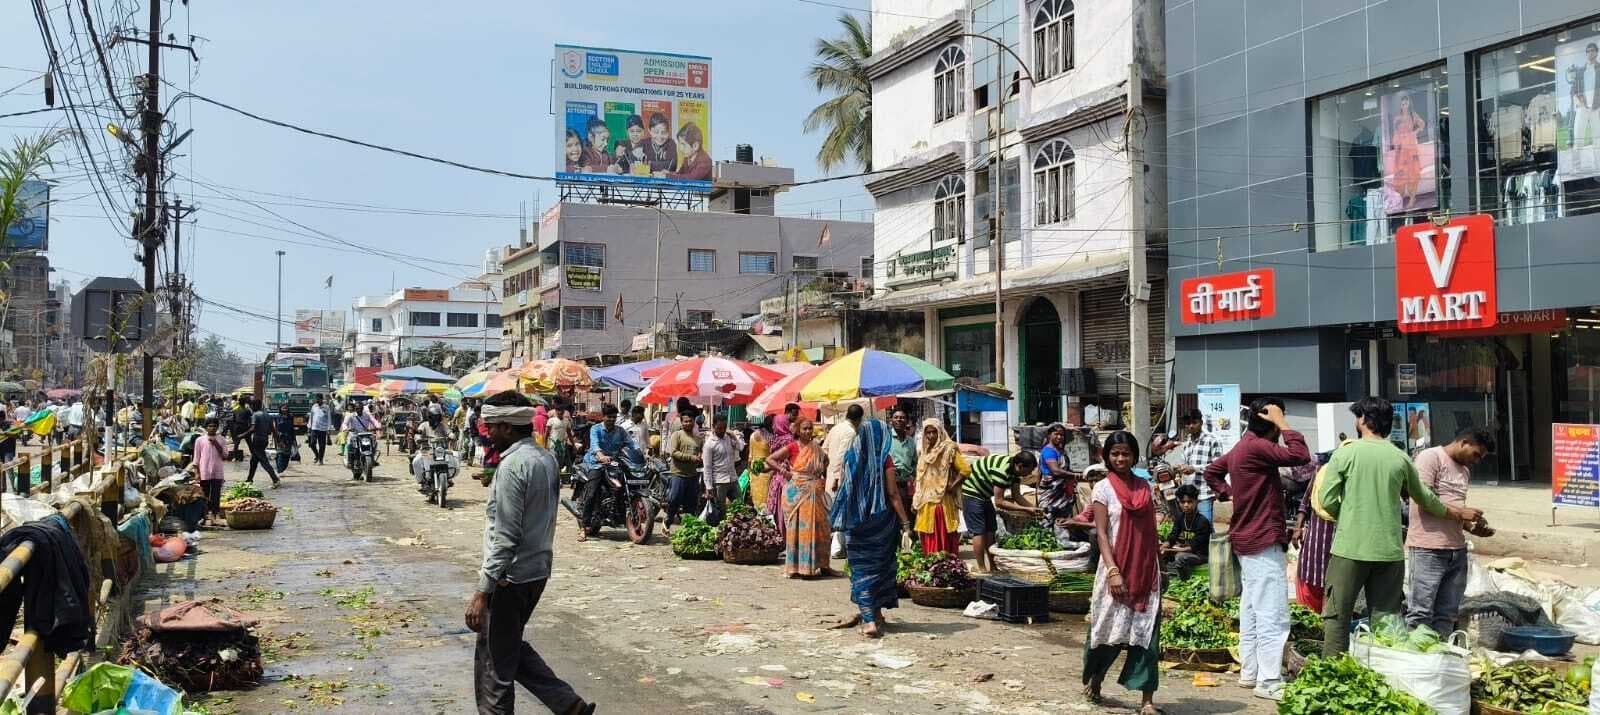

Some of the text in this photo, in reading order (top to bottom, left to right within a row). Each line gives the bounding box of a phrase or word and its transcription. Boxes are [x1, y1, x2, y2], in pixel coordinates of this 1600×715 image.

[643, 57, 686, 69] ADMISSION
[643, 67, 665, 76] OPEN
[564, 82, 705, 100] BUILDING STRONG FOUNDATIONS FOR 25 YEARS
[1413, 225, 1468, 288] V
[1187, 274, 1263, 315] वी मार्ट
[1400, 290, 1488, 323] MART
